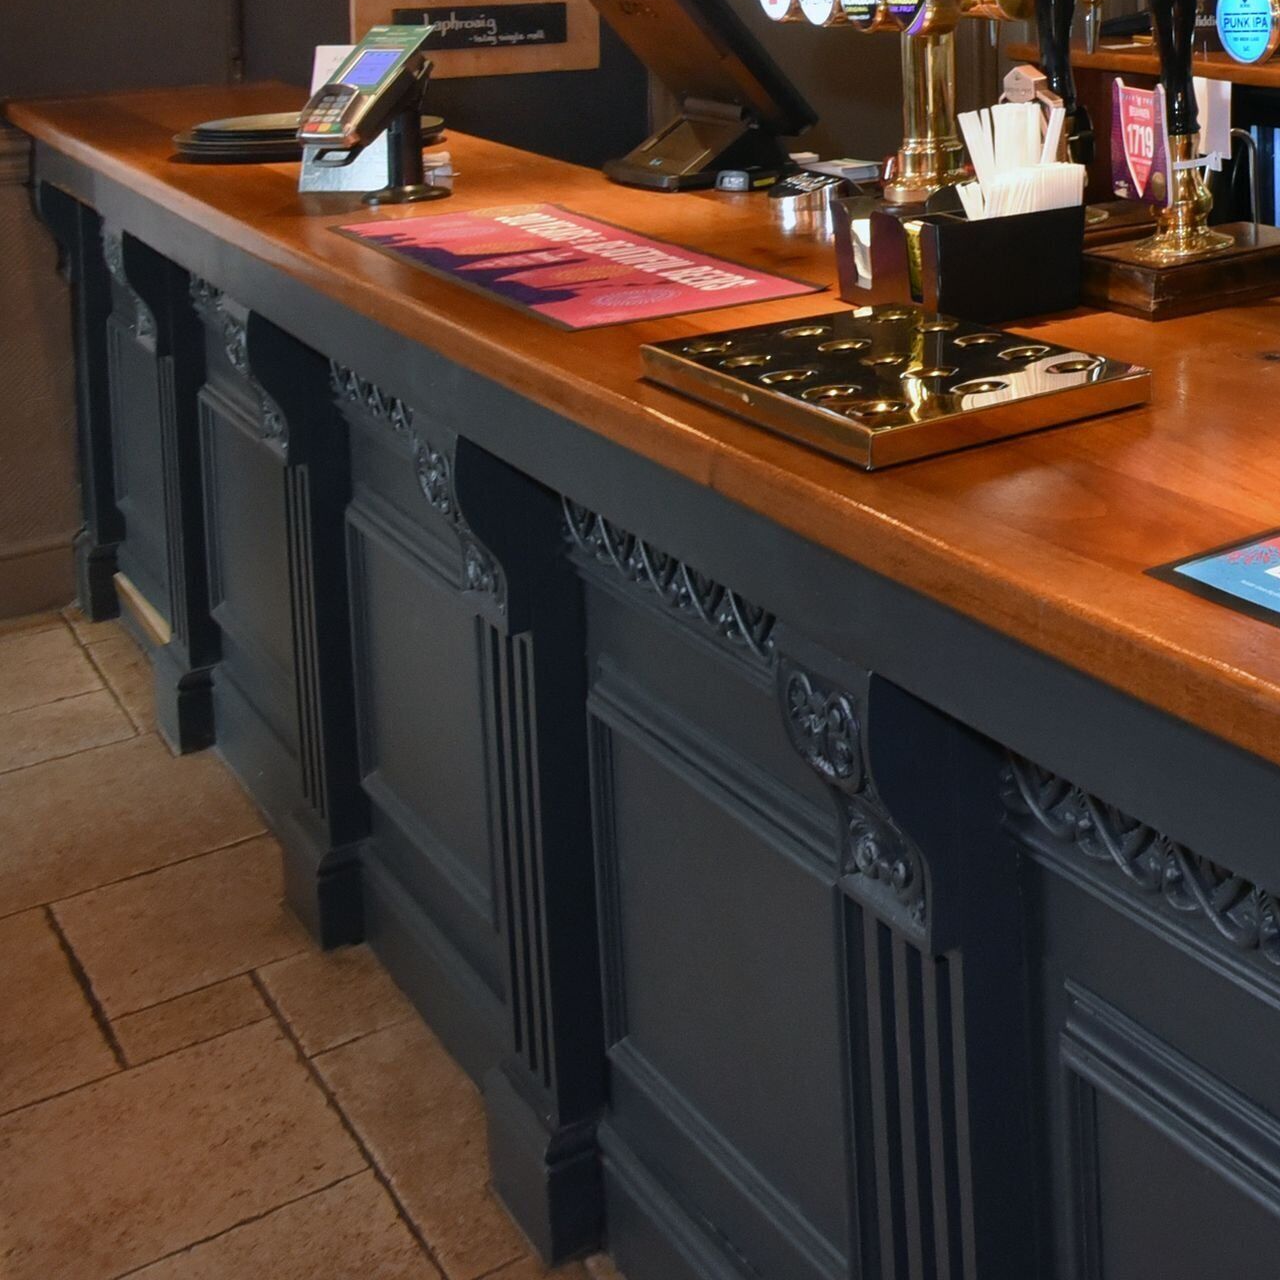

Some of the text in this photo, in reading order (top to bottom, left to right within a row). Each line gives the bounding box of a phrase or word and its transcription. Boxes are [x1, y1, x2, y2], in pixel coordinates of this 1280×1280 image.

[423, 12, 497, 37] Laphroaig
[1224, 17, 1250, 28] PUNK
[1252, 16, 1269, 28] IPA
[1127, 123, 1154, 158] 1719
